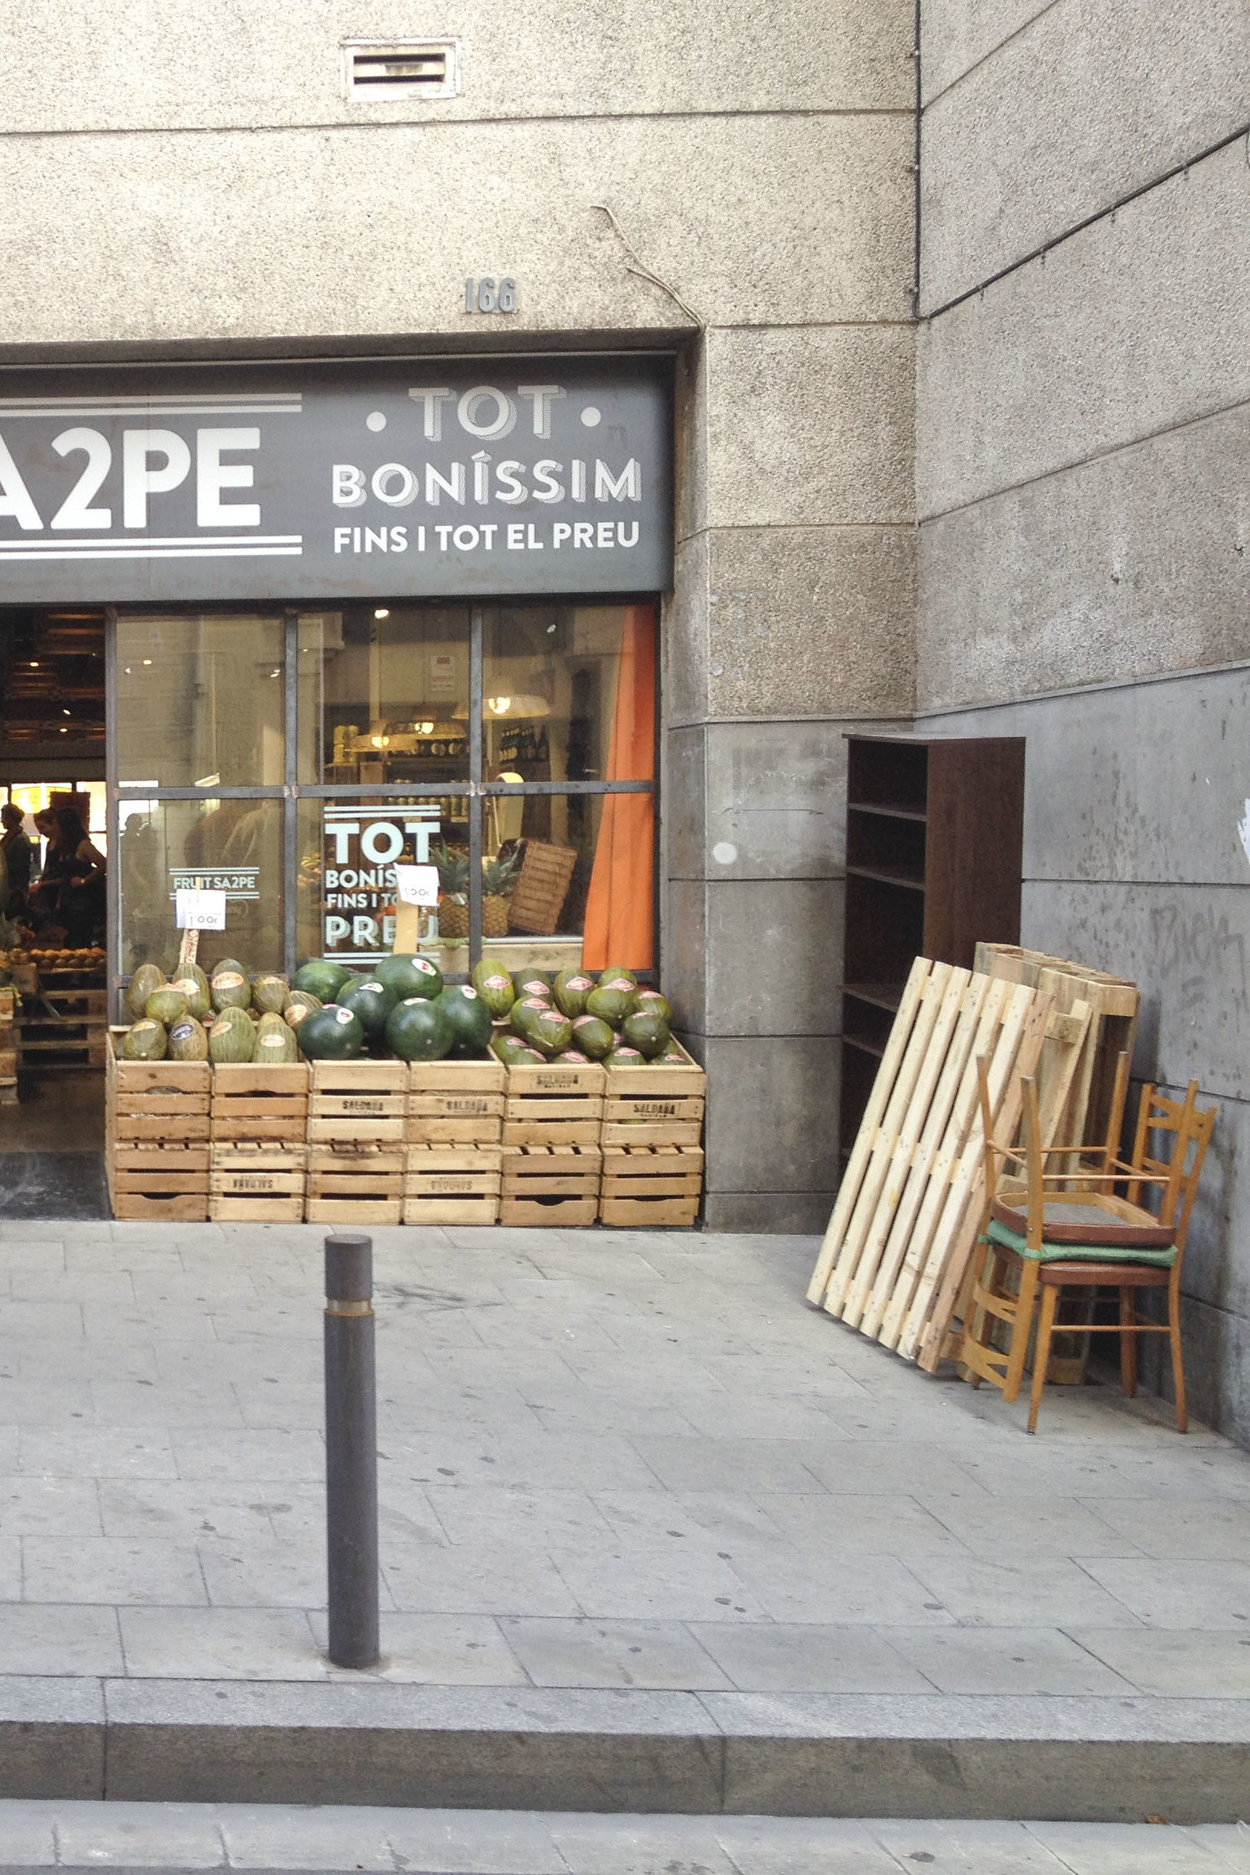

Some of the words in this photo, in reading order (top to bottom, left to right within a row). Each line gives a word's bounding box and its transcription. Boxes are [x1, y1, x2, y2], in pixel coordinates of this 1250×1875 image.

[465, 277, 517, 313] 166
[408, 384, 567, 442] TOT
[332, 450, 642, 508] BONÍSSIM
[334, 525, 408, 553] FINS
[418, 525, 425, 551] I
[435, 524, 498, 551] TOT
[507, 523, 544, 549] EL
[553, 521, 640, 549] PREU
[324, 821, 441, 864] TOT
[173, 877, 213, 889] FRUIT
[214, 876, 255, 889] SA2PE
[325, 864, 398, 889] BONÍS
[327, 893, 367, 908] FINS
[371, 893, 378, 908] I
